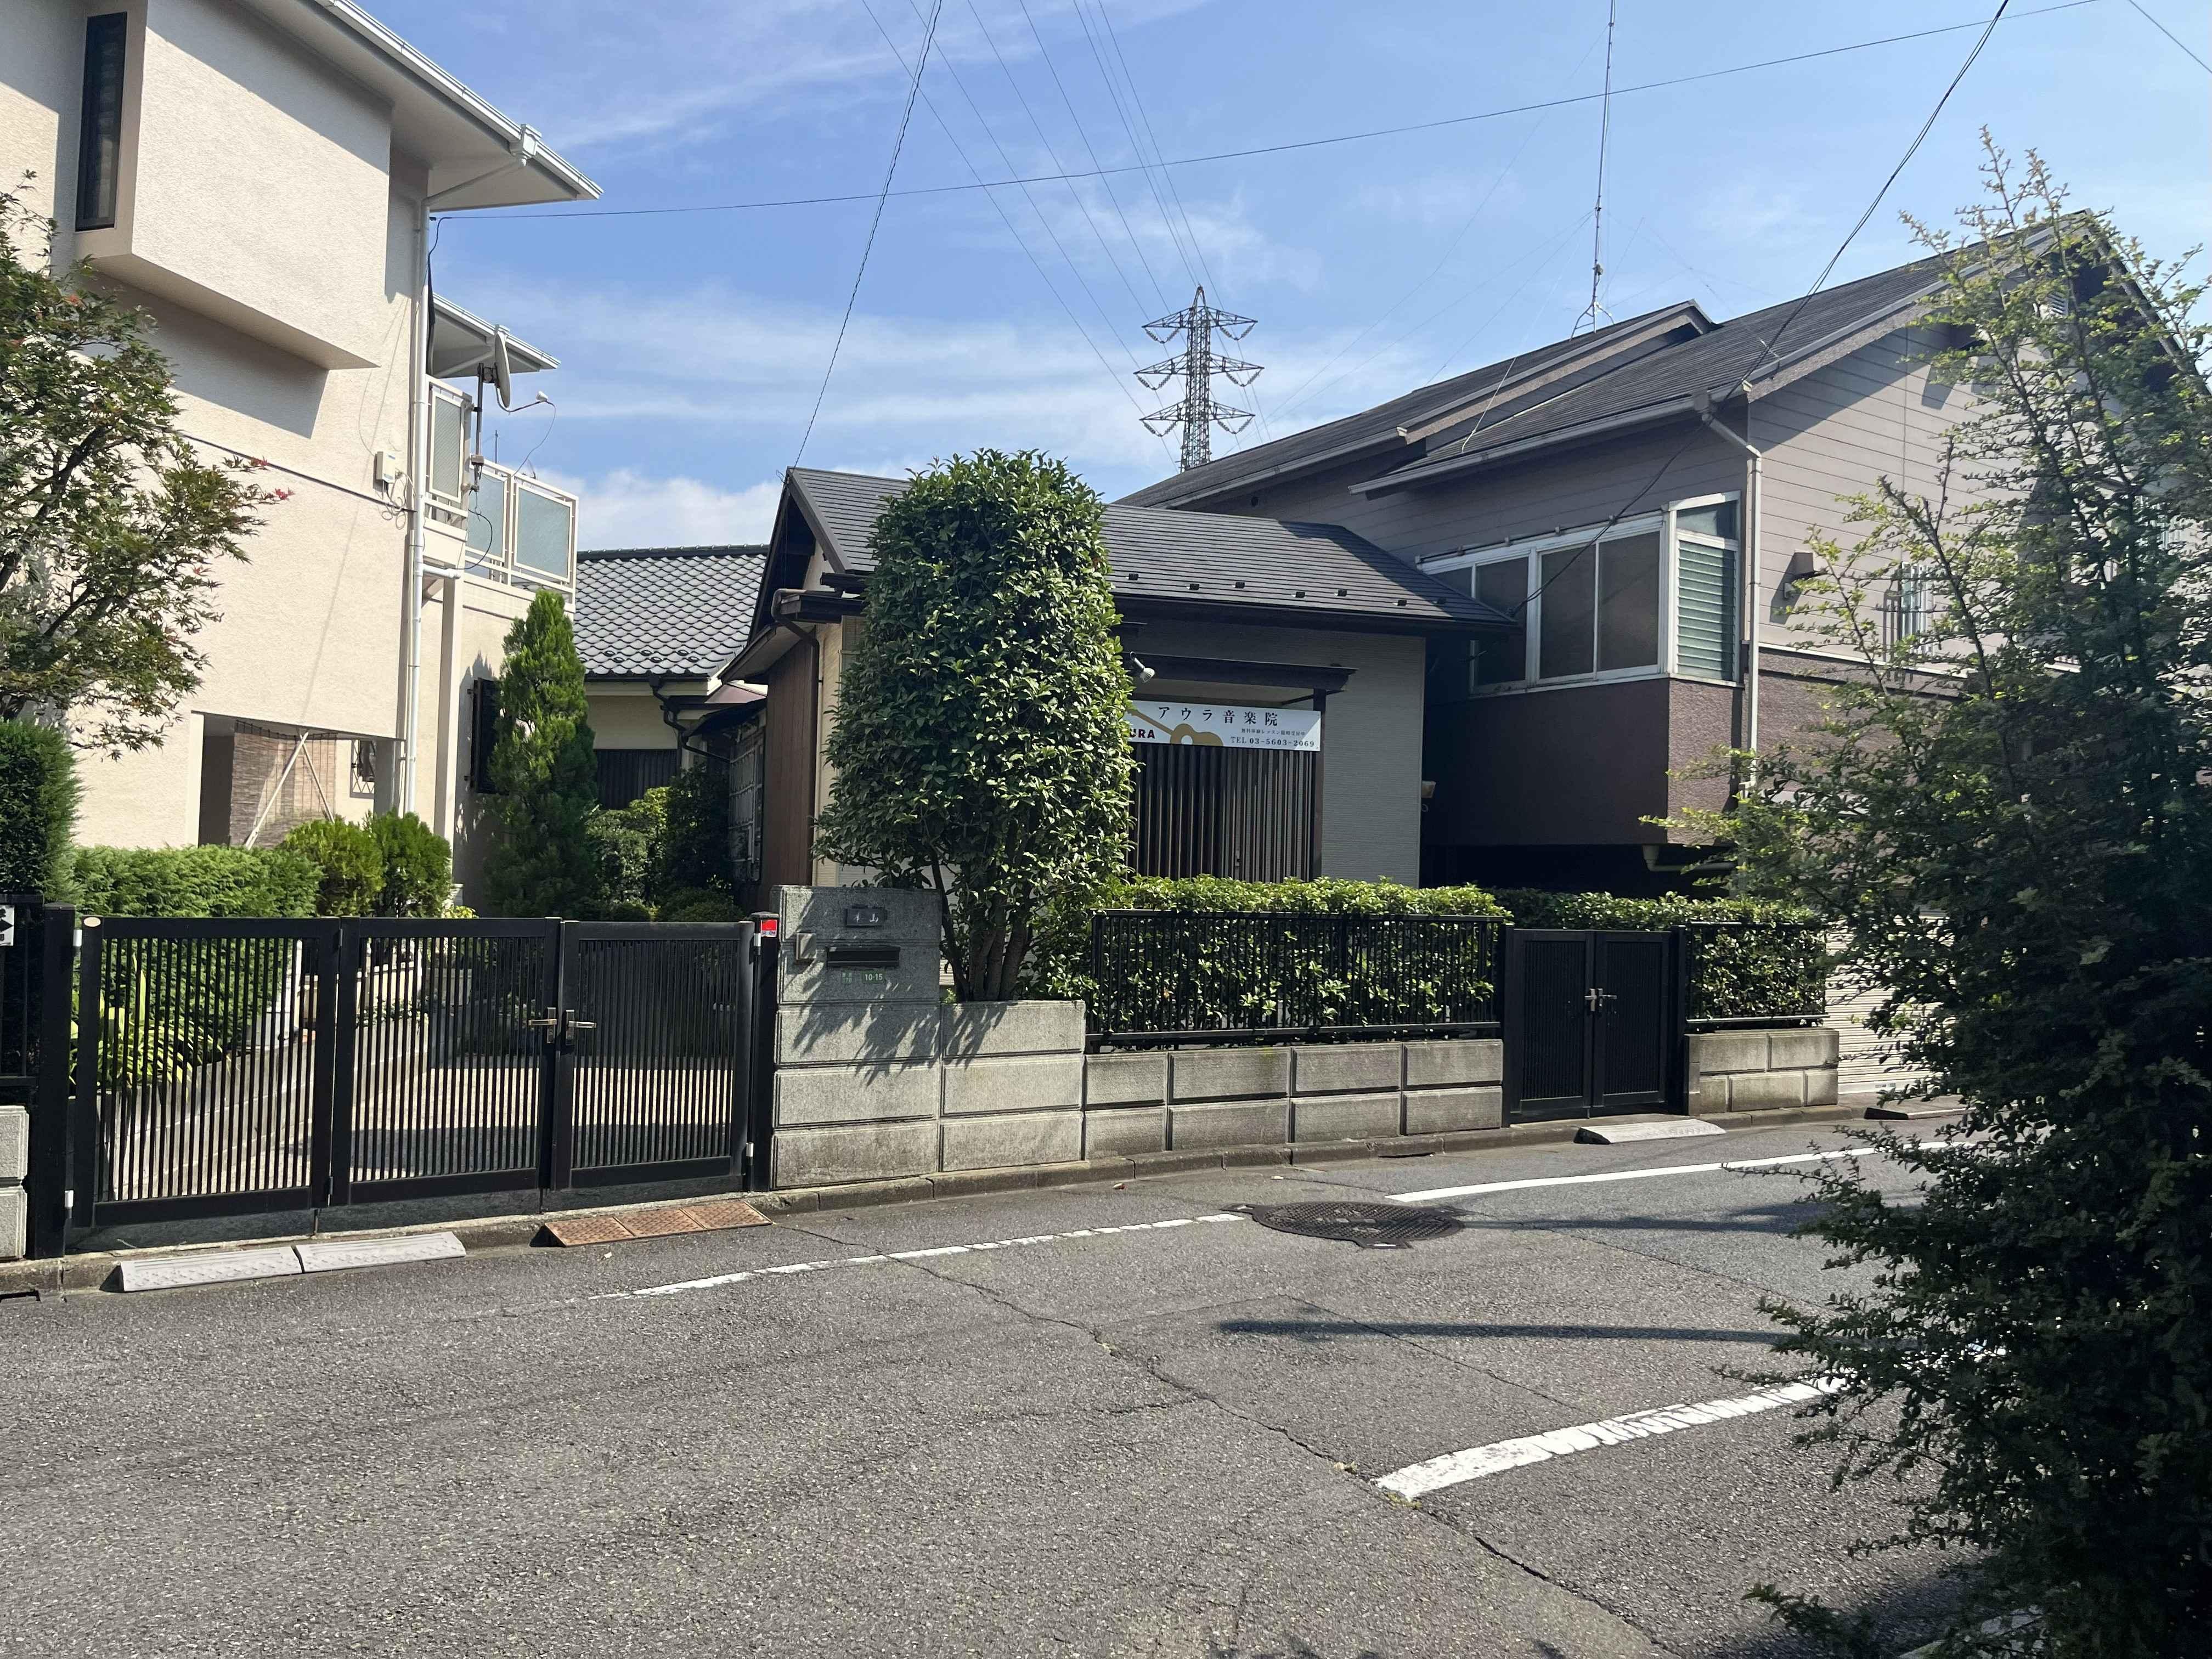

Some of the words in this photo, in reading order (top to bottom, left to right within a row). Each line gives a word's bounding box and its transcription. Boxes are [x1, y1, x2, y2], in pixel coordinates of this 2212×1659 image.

[1158, 706, 1278, 726] アウラ音楽院
[1130, 728, 1155, 739] URA
[1231, 736, 1246, 744] TEL
[1249, 737, 1314, 747] 03-5603-2069
